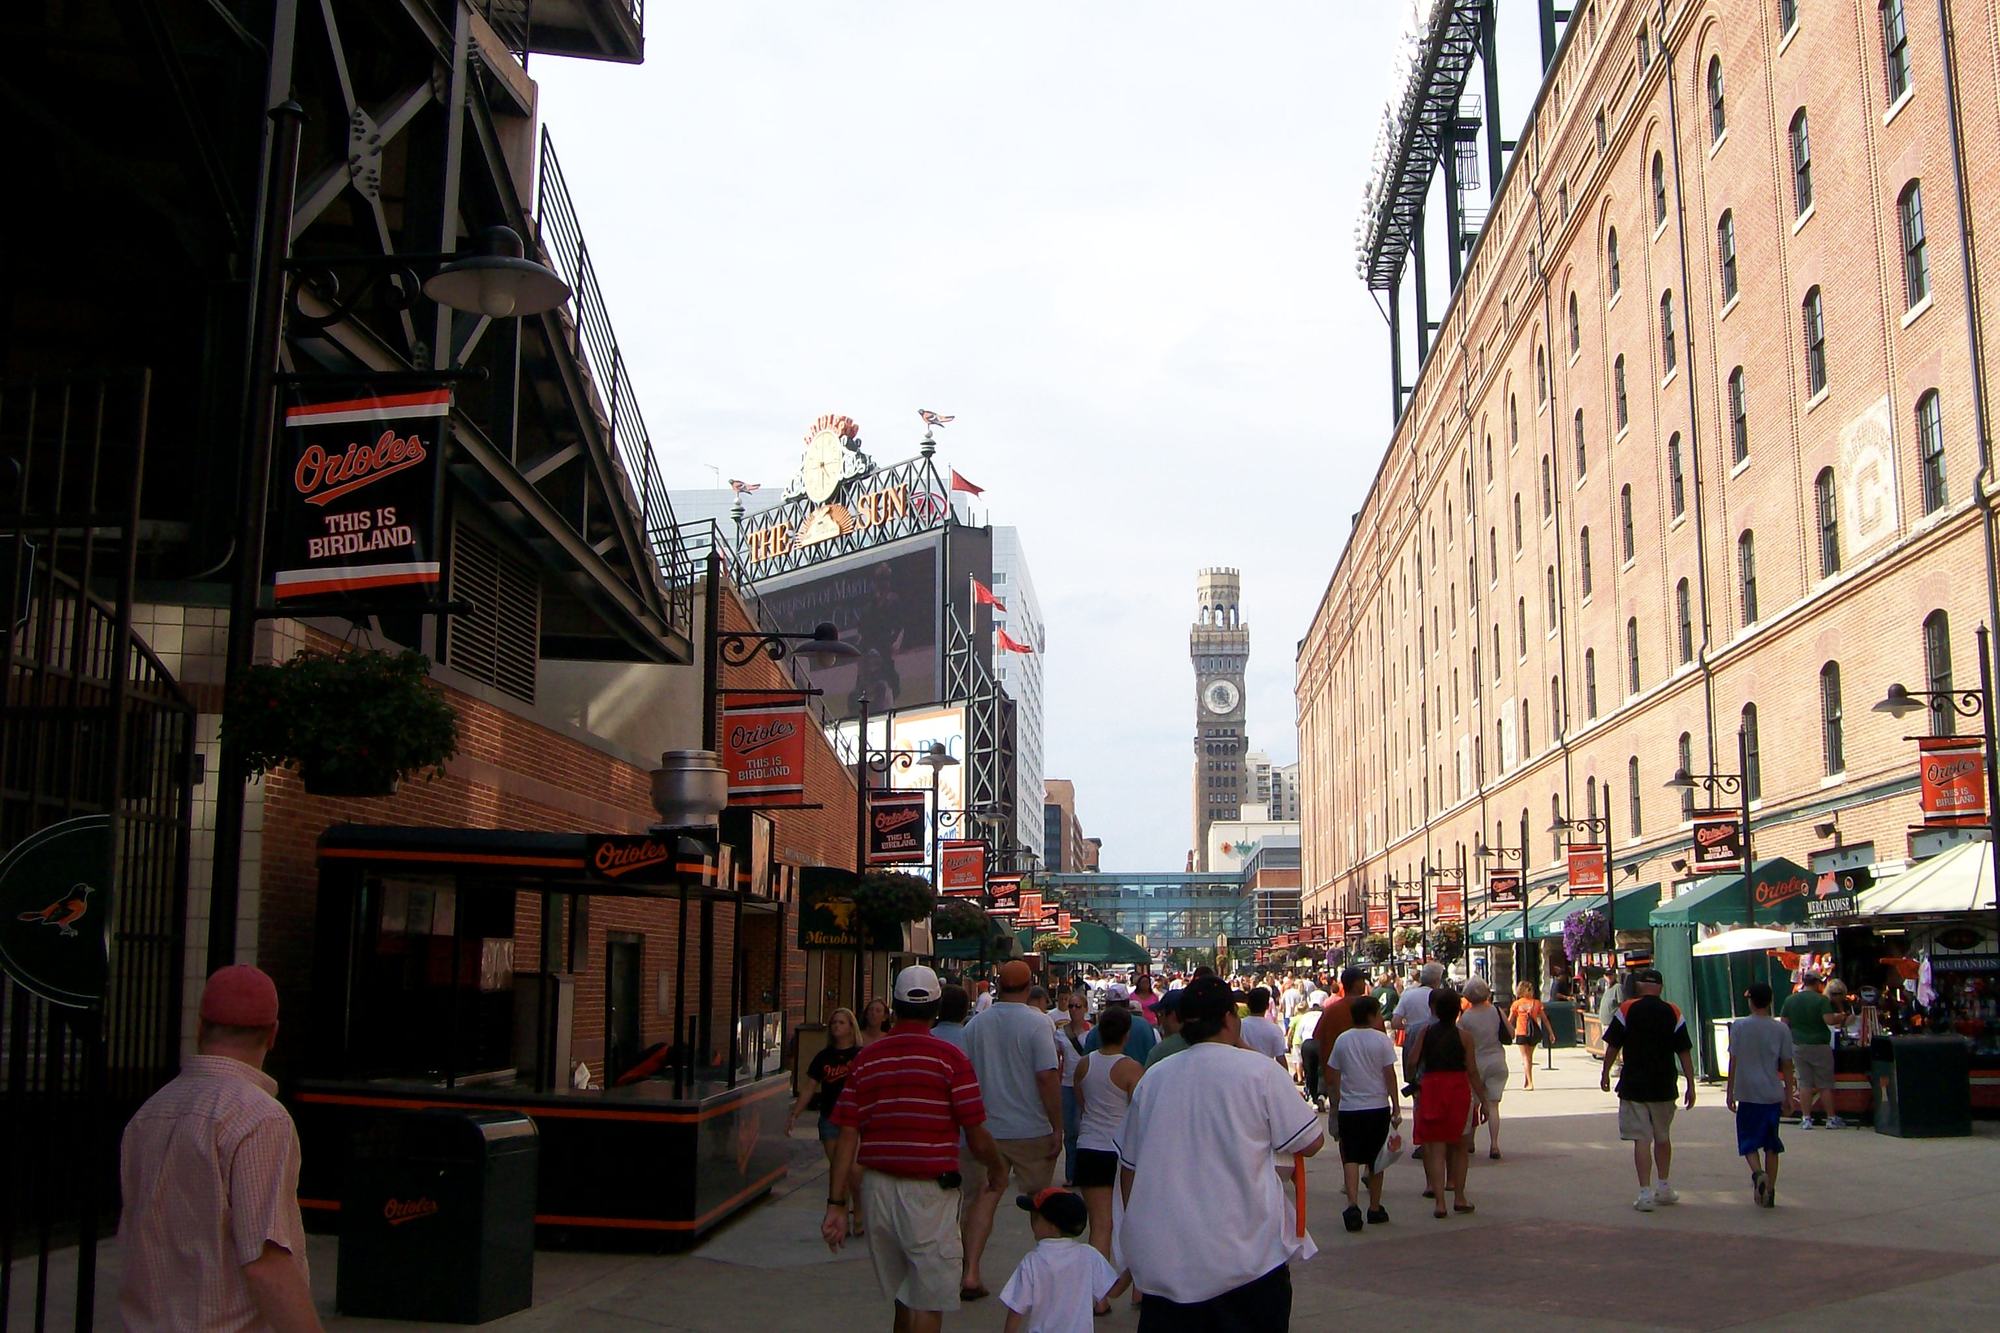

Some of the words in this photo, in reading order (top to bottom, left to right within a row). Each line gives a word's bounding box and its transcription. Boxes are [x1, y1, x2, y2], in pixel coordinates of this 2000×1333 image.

[294, 430, 426, 500] Orioles
[325, 510, 372, 534] THIS
[376, 507, 397, 526] IS
[747, 520, 793, 564] THE
[853, 482, 909, 531] SUN
[308, 525, 417, 559] BIRDLAND.
[730, 720, 796, 752] Orioles
[746, 758, 769, 769] THIS
[772, 756, 782, 766] IS
[1927, 759, 1976, 783] Orioles
[875, 808, 919, 829] Orioles
[594, 840, 669, 871] Orioles
